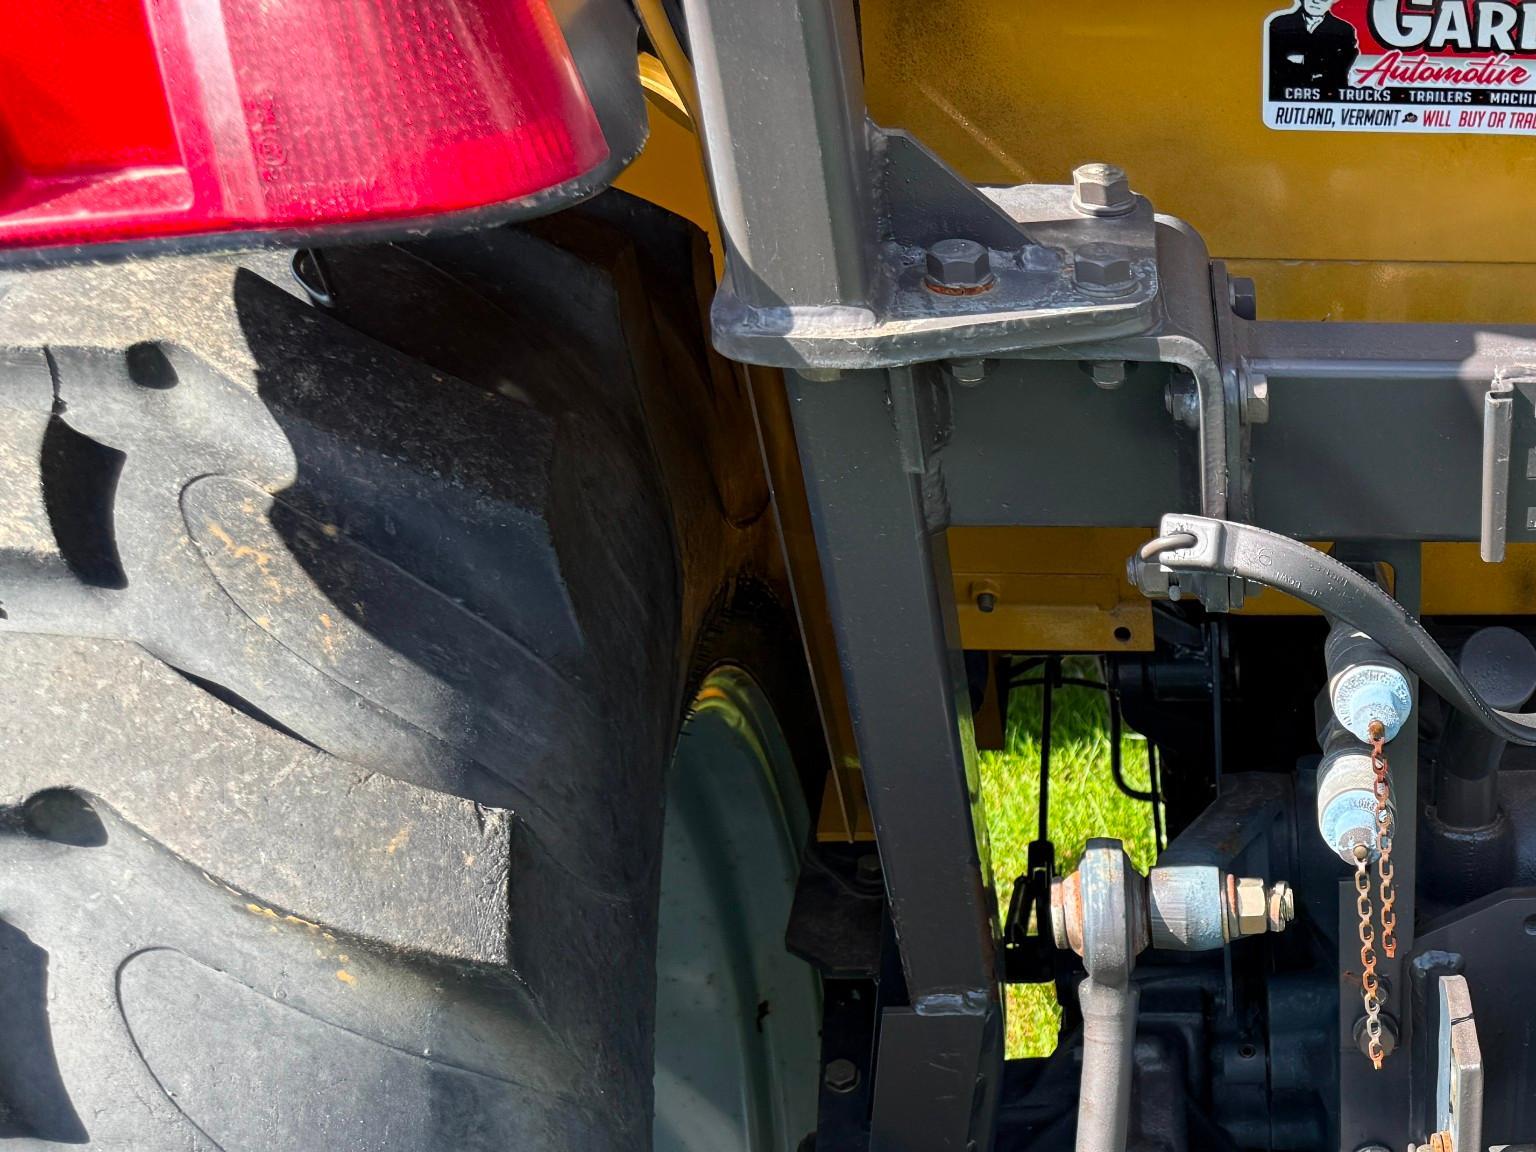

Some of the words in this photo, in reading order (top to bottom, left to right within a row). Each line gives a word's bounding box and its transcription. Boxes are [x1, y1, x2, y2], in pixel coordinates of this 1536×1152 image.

[1355, 51, 1531, 86] Automotive
[1284, 87, 1321, 100] CARS
[1338, 88, 1391, 101] TRUCKS
[1409, 90, 1472, 103] TRAILERS
[1275, 107, 1336, 128] RUTLAND,
[1341, 108, 1401, 126] VERMONT
[1423, 110, 1451, 127] WILL
[1458, 110, 1486, 128] BUY
[1487, 111, 1507, 128] OR
